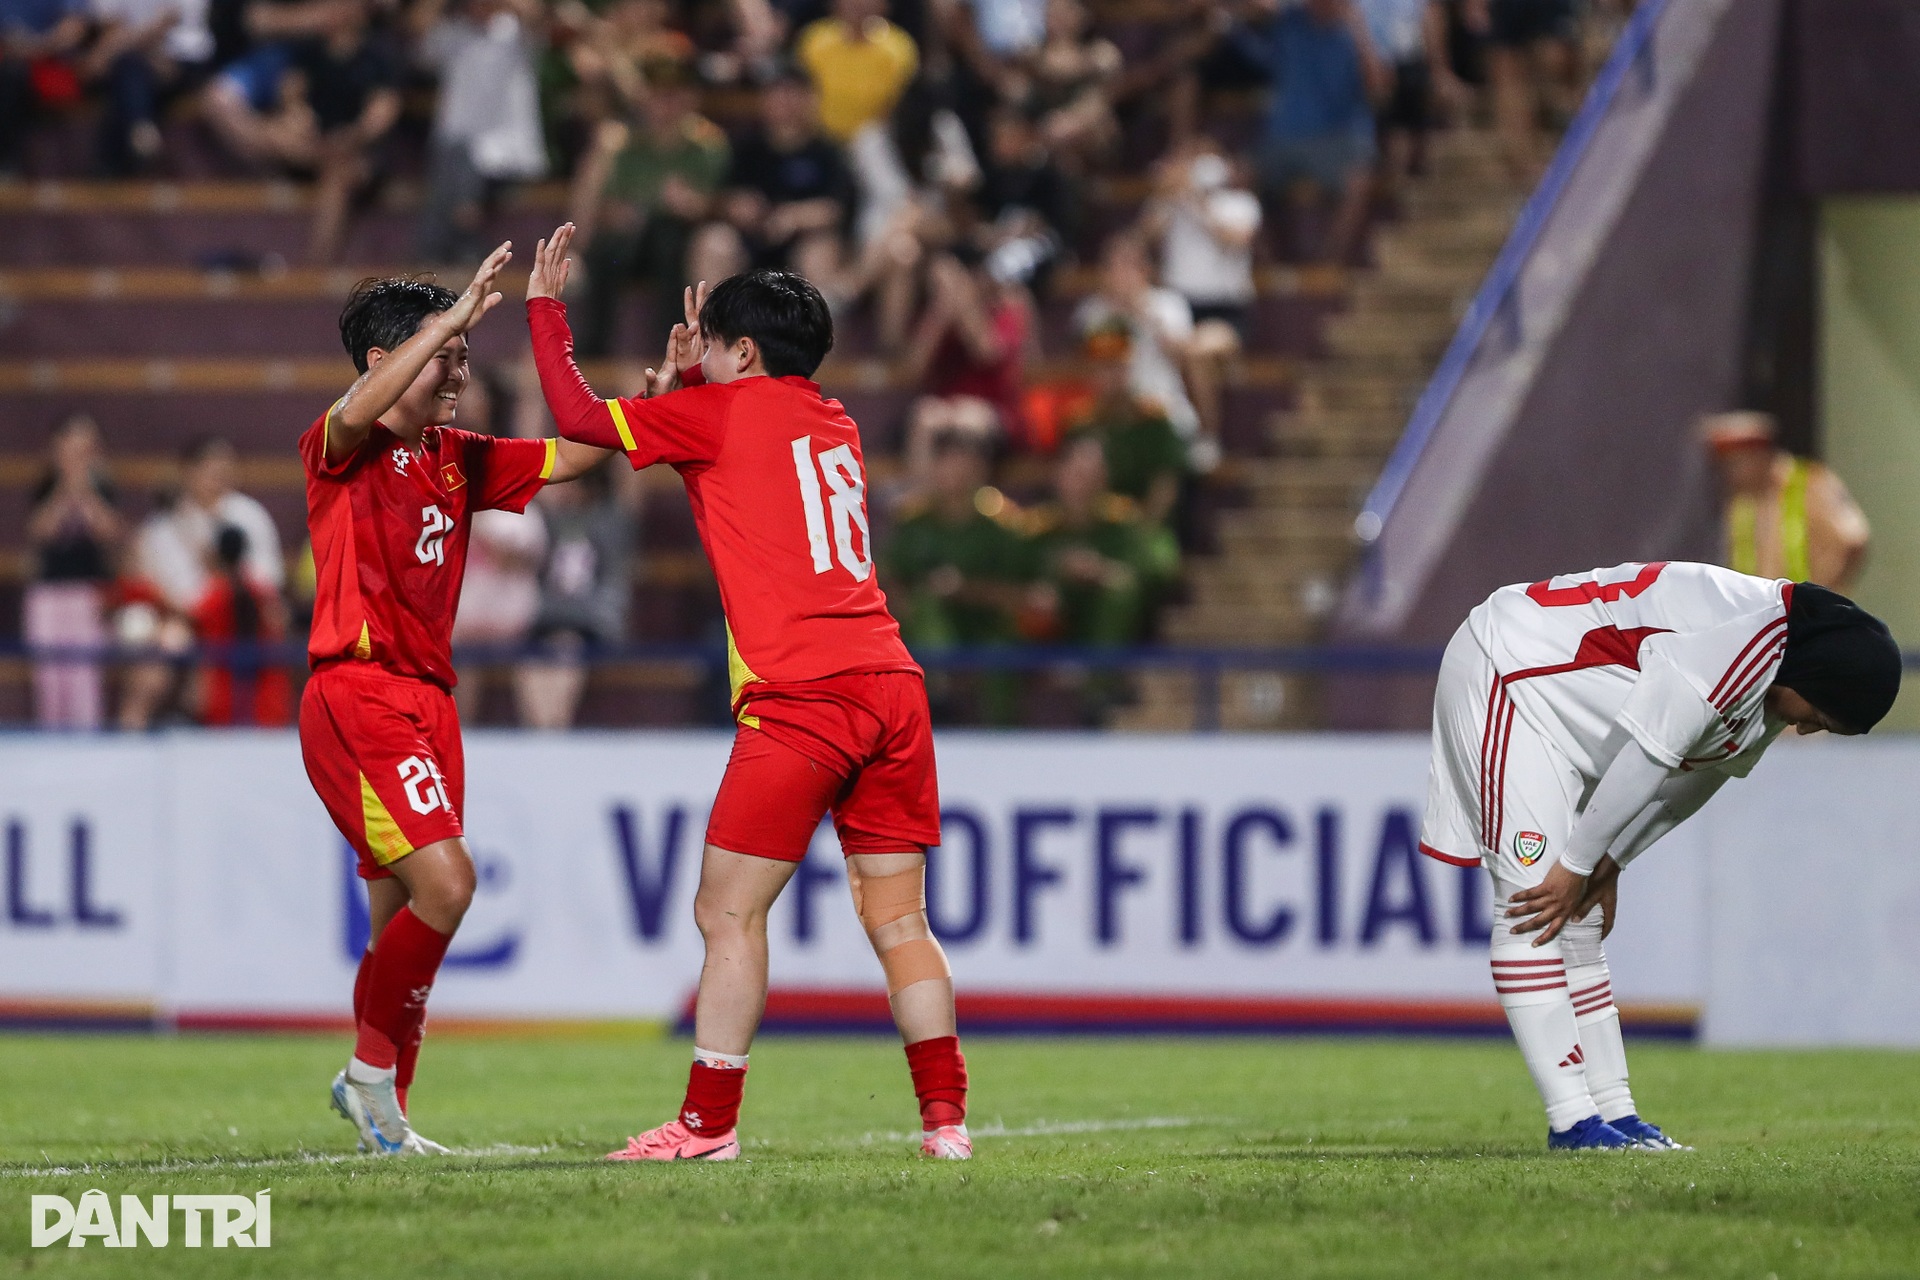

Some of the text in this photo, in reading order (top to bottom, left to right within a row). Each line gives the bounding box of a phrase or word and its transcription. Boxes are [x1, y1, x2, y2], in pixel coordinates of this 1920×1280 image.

[415, 504, 455, 567] 21
[791, 435, 872, 583] 18
[396, 755, 451, 816] 21
